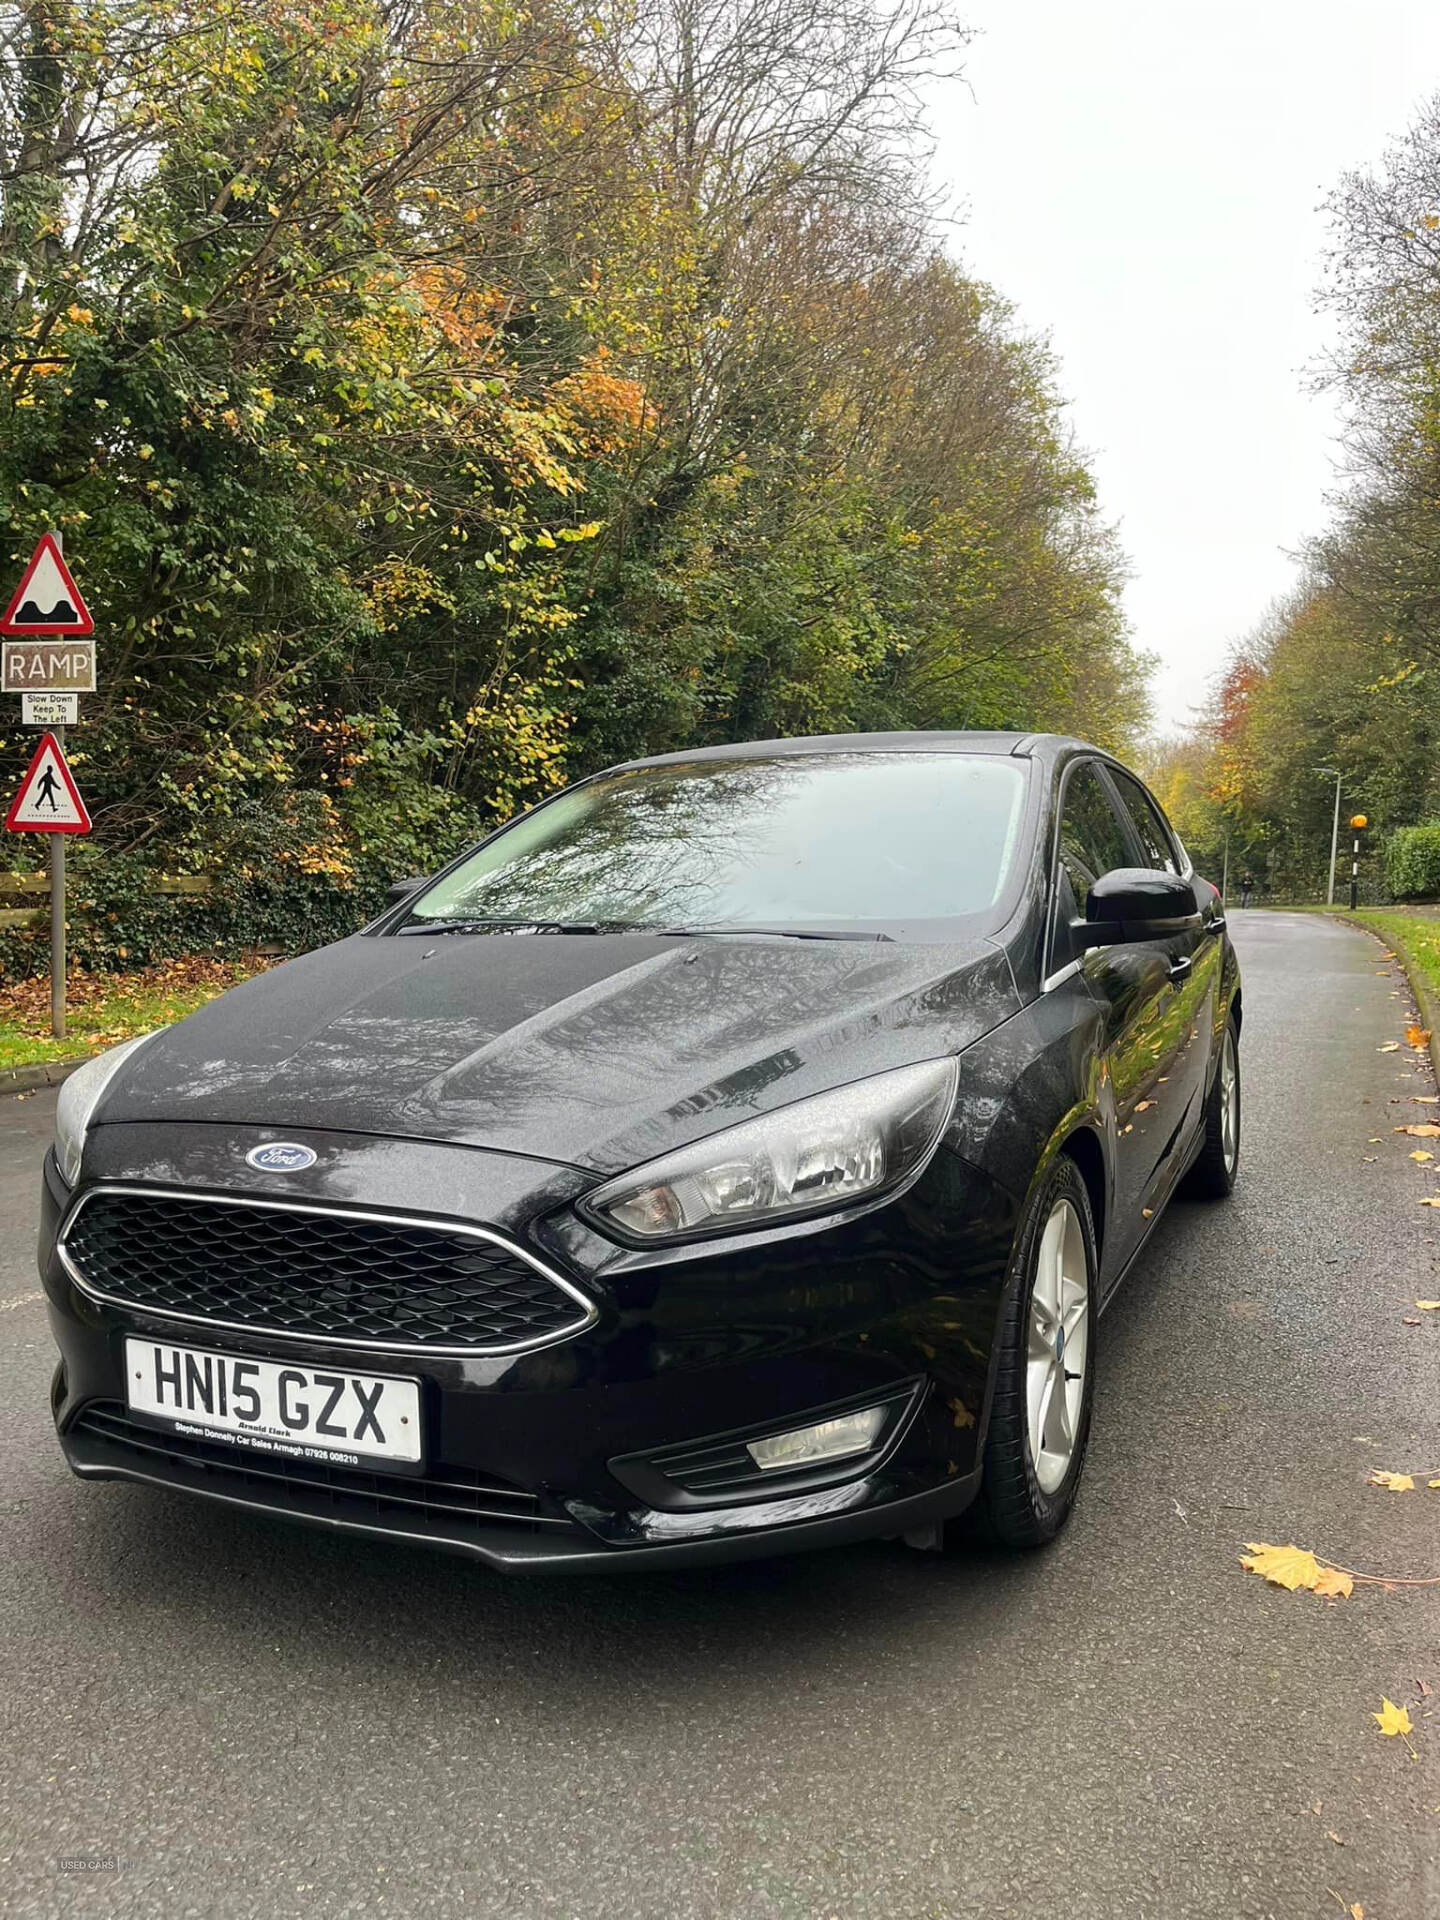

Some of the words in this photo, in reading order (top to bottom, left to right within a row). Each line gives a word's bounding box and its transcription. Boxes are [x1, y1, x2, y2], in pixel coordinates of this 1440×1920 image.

[10, 654, 89, 679] RAMP
[27, 694, 47, 703] Slow
[50, 694, 73, 703] Down
[33, 705, 54, 714] Keep
[57, 705, 67, 713] To
[33, 715, 48, 723] The
[51, 715, 67, 723] Left
[260, 1148, 302, 1165] Ford
[154, 1347, 261, 1422] HN15
[278, 1369, 387, 1444] GZX
[238, 1421, 267, 1433] Arnold
[269, 1427, 291, 1437] Clark
[175, 1421, 203, 1436] Stephen
[204, 1428, 236, 1444] Donnelly
[236, 1435, 250, 1445] Car
[251, 1438, 272, 1450] Sales
[273, 1442, 304, 1456] Armagh
